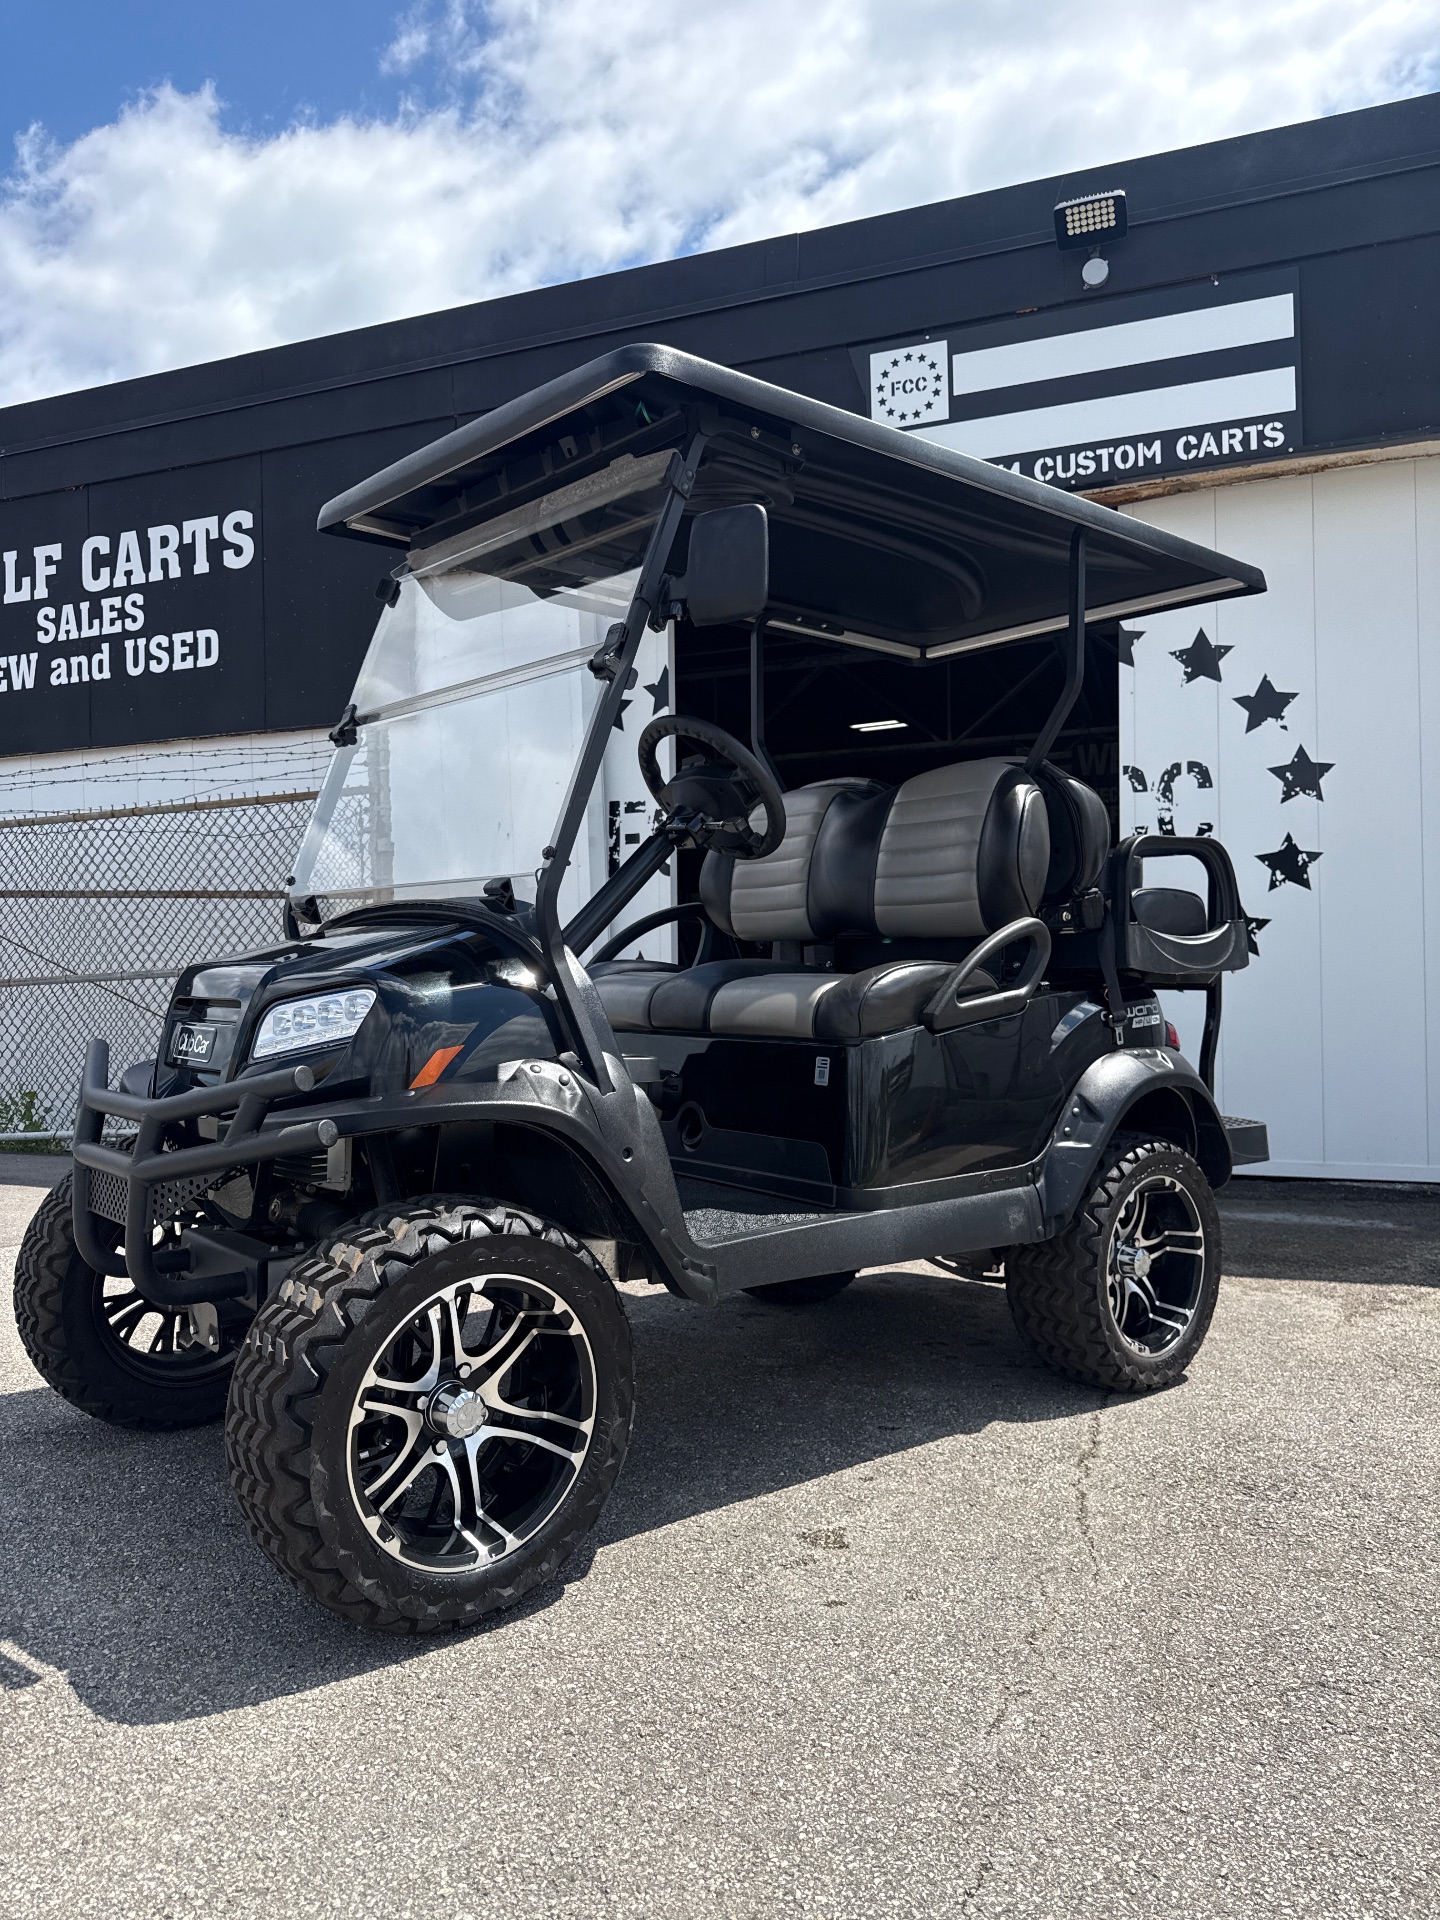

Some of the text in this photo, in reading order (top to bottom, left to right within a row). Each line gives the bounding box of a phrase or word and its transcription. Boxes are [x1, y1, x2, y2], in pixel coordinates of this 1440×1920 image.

[891, 376, 927, 397] FCC
[1033, 421, 1285, 482] CUSTOM CARTS
[81, 509, 255, 593] CARTS
[36, 592, 145, 644] SALES
[50, 642, 111, 686] and
[124, 628, 219, 677] USED
